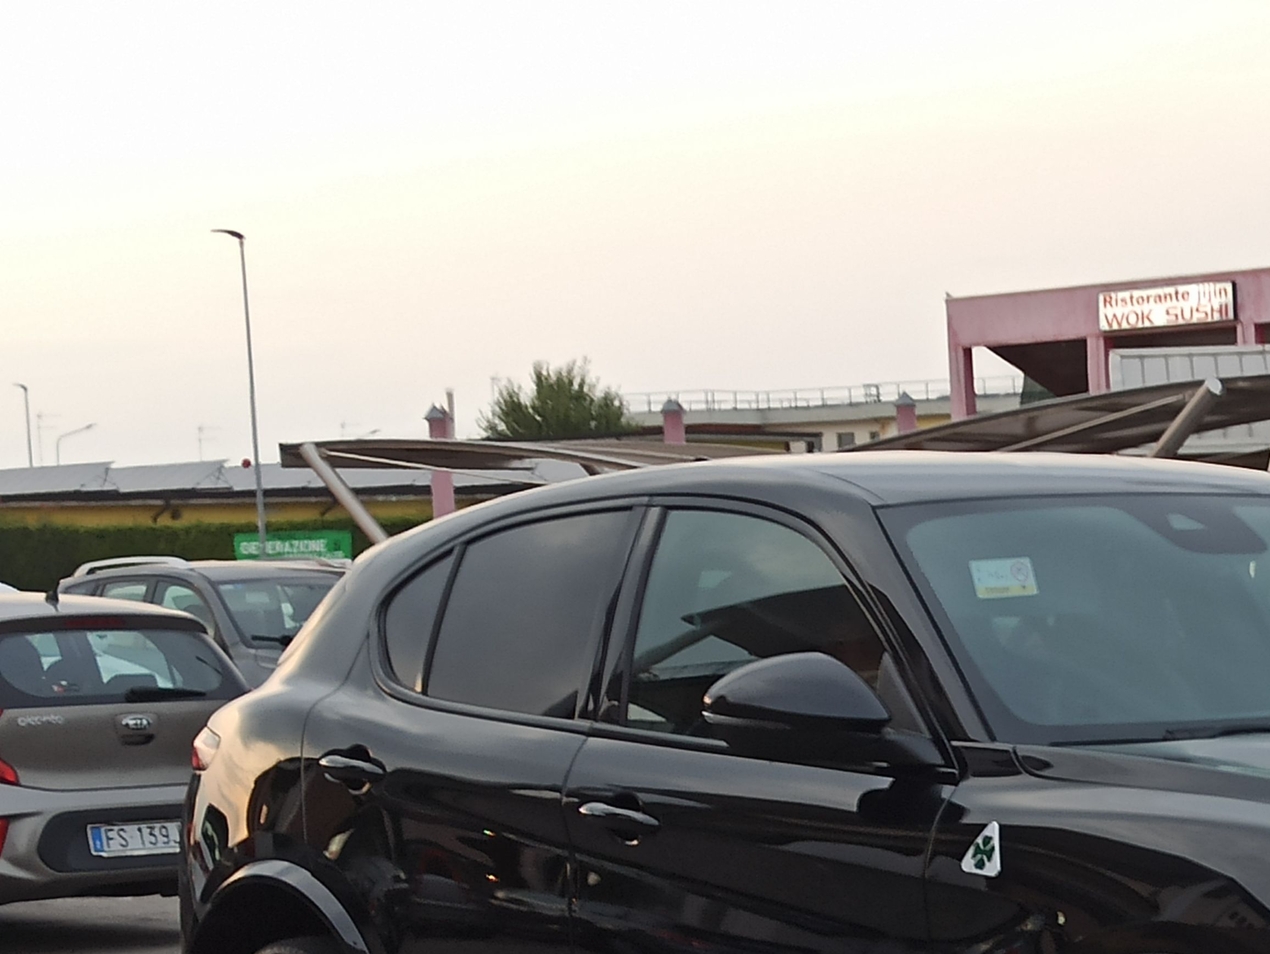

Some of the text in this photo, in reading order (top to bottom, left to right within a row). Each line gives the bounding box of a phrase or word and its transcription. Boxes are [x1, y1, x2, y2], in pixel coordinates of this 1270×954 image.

[1103, 287, 1190, 309] Ristorante
[1104, 303, 1229, 329] WOK SUSHI
[104, 826, 129, 848] FS
